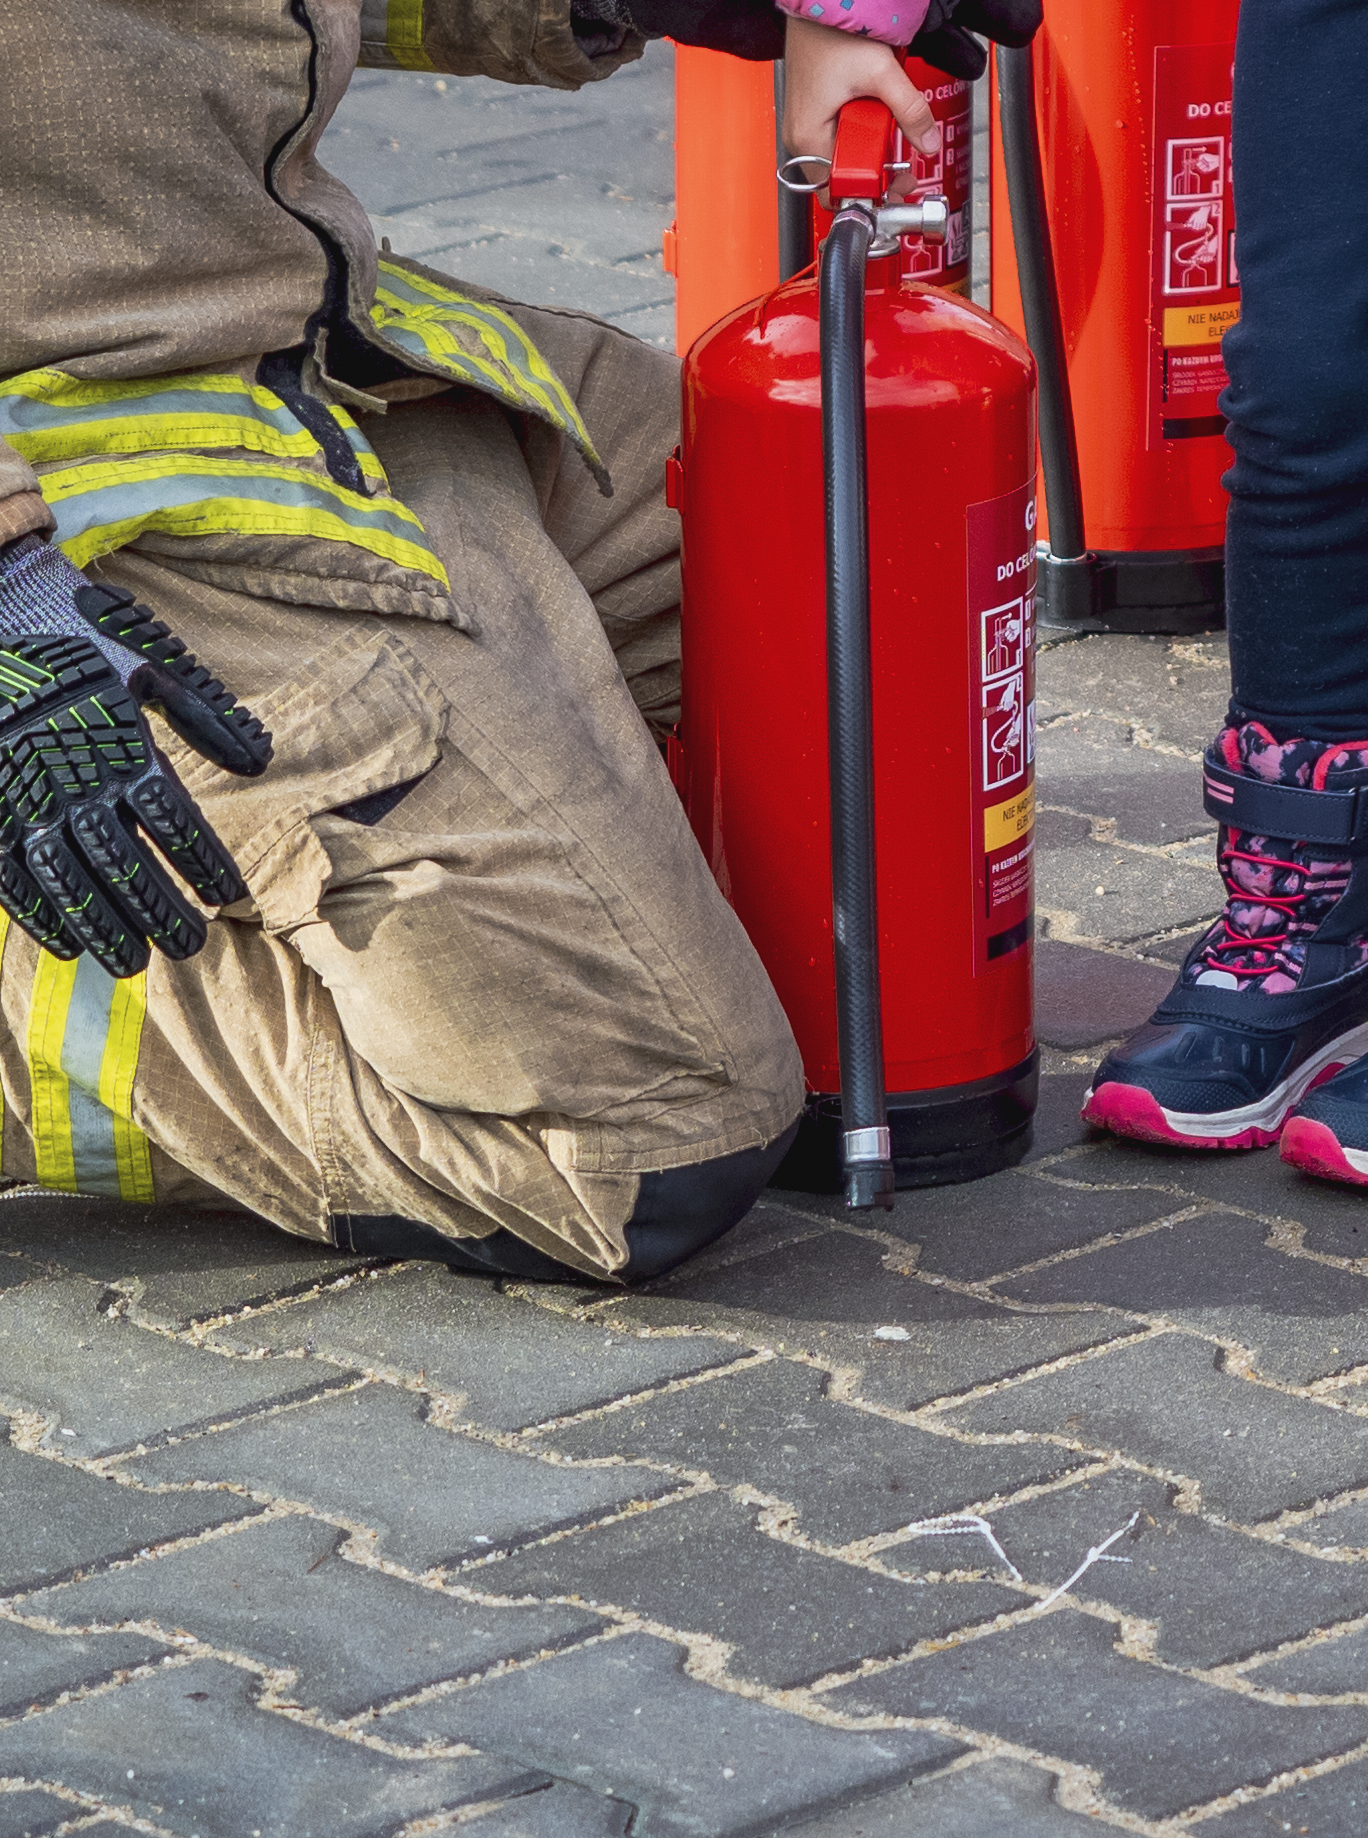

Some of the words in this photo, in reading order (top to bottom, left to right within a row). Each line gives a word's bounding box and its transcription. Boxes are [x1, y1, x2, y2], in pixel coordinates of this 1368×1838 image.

[1188, 103, 1211, 117] DO
[1214, 100, 1233, 115] CE
[1188, 313, 1206, 324] NIE
[1209, 310, 1239, 322] NADAJ
[1209, 325, 1227, 337] ELE
[997, 561, 1014, 582] DO
